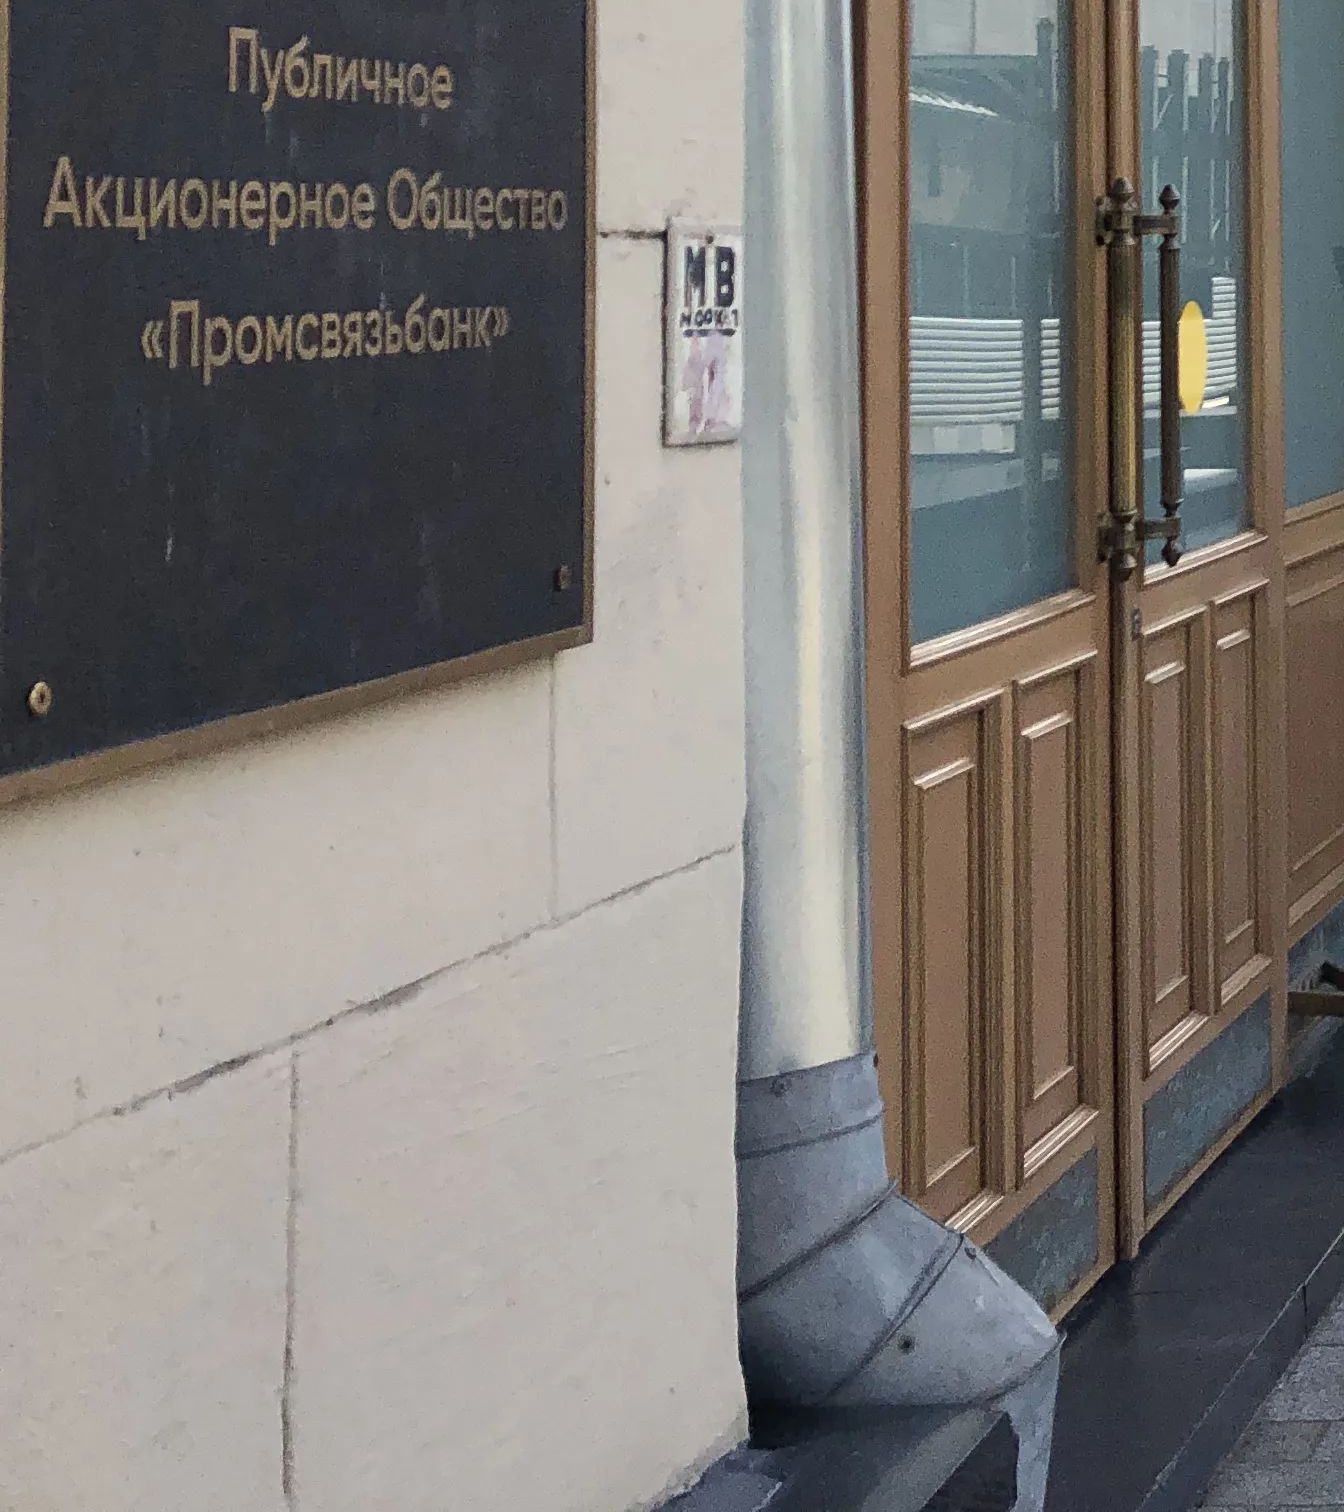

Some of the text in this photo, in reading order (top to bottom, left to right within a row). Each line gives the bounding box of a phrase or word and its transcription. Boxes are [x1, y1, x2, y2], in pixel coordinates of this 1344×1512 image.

[228, 27, 453, 112] Публичное
[43, 156, 569, 245] Акционерное Общество
[140, 294, 512, 385] «Промсвязьбанк»
